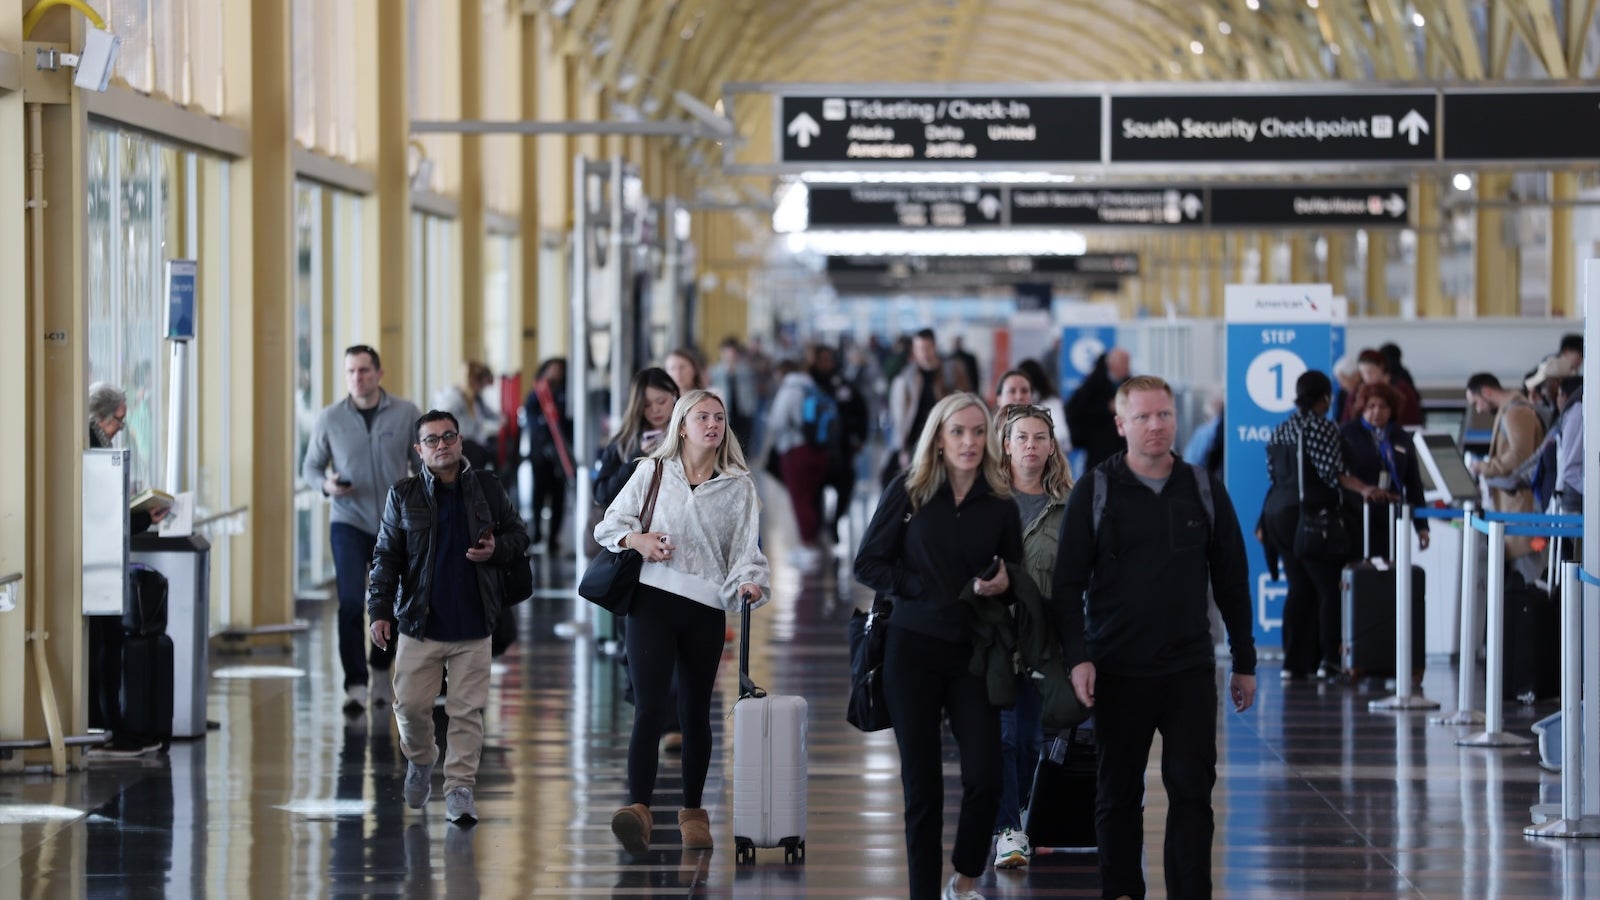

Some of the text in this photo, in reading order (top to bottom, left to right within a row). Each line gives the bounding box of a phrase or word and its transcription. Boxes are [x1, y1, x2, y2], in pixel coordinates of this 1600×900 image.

[848, 99, 934, 123] Ticketing
[948, 99, 1030, 120] Check-In
[847, 124, 1036, 141] Alaska Delta United
[1122, 117, 1368, 142] South Security Checkpoint
[847, 142, 977, 158] American JetBlue
[1255, 299, 1303, 309] American
[1261, 329, 1296, 344] STEP
[1268, 363, 1283, 400] 1
[1237, 426, 1271, 442] TAG
